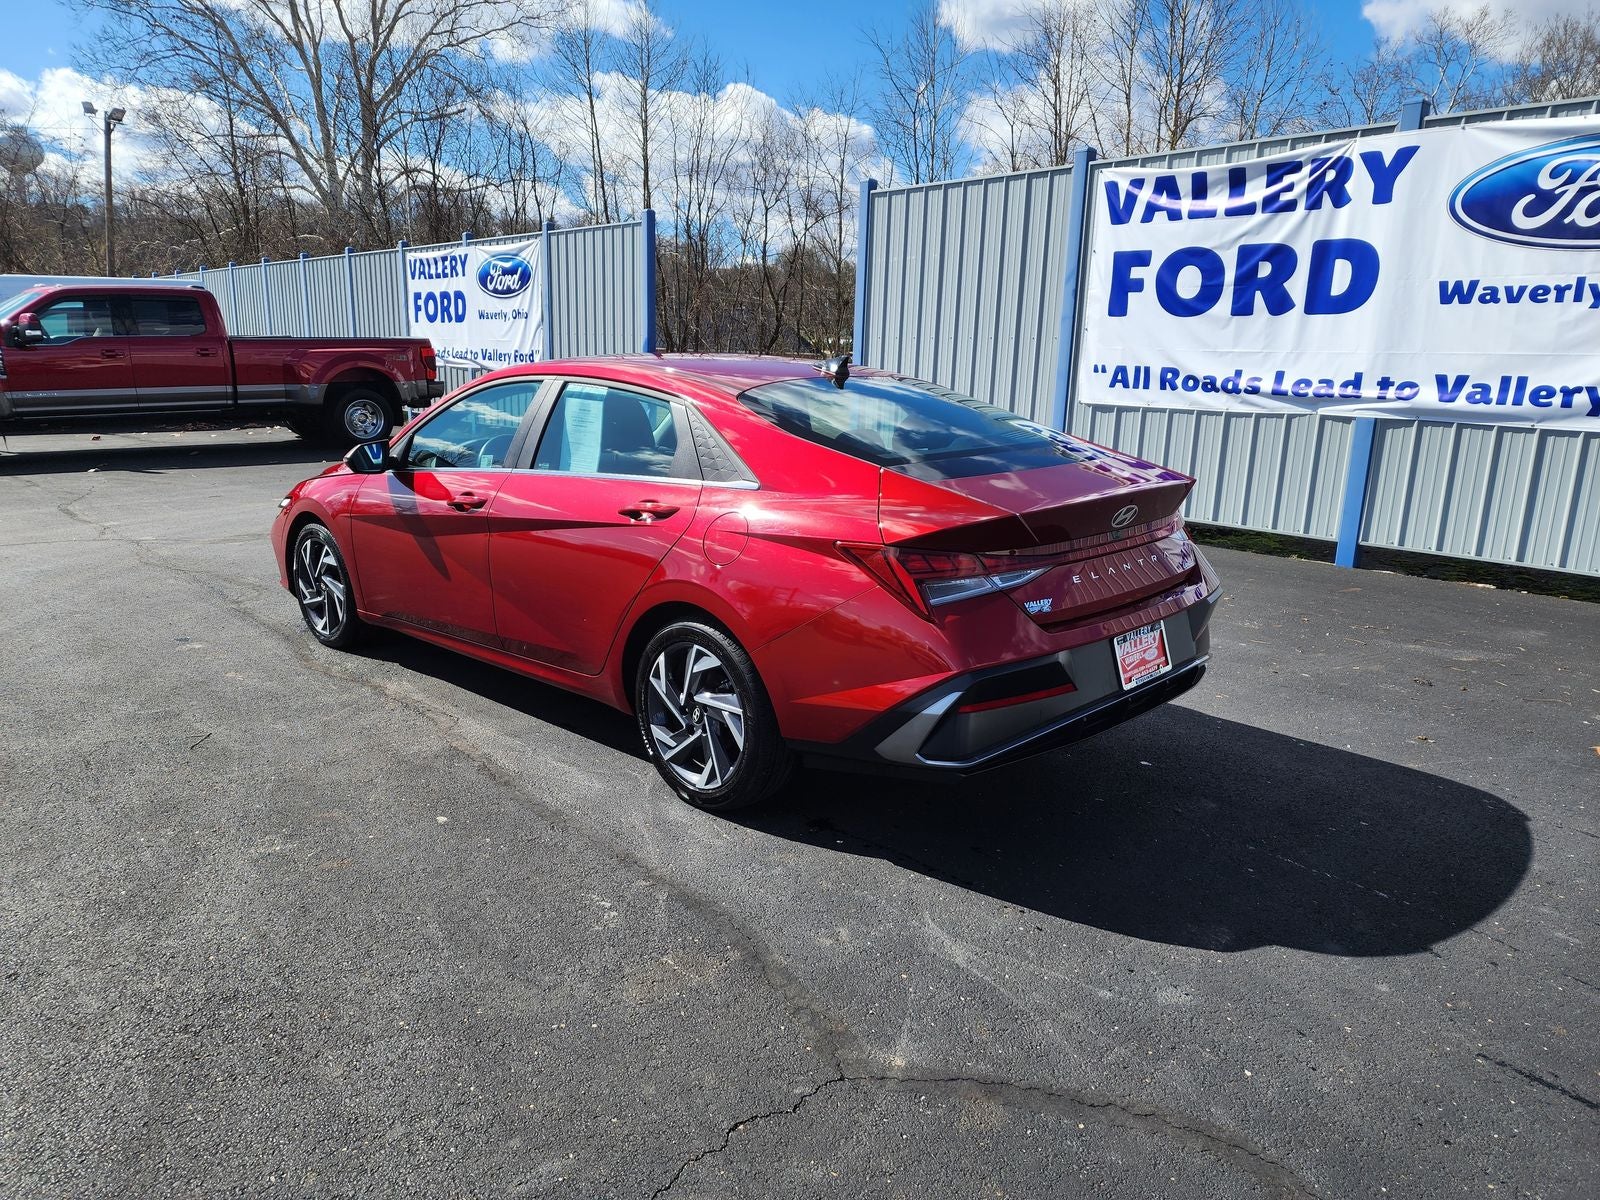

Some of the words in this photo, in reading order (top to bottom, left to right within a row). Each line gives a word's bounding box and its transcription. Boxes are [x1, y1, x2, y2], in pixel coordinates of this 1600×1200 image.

[1104, 145, 1422, 226] VALLERY
[1511, 153, 1600, 230] Fo
[408, 253, 469, 281] VALLERY
[487, 260, 522, 291] Ford
[1107, 238, 1380, 318] FORD
[413, 290, 467, 323] FORD
[477, 309, 511, 322] Waverly,
[511, 309, 529, 320] Ohio
[434, 347, 450, 359] ads
[451, 347, 468, 359] Lead
[470, 348, 479, 360] to
[480, 348, 512, 365] Vallery
[1159, 366, 1263, 395] Roads
[1271, 370, 1364, 399] Lead
[1376, 376, 1420, 401] to
[1072, 551, 1170, 584] ELANTRA
[1024, 597, 1053, 608] VALLERY
[1116, 630, 1160, 657] VALLERY
